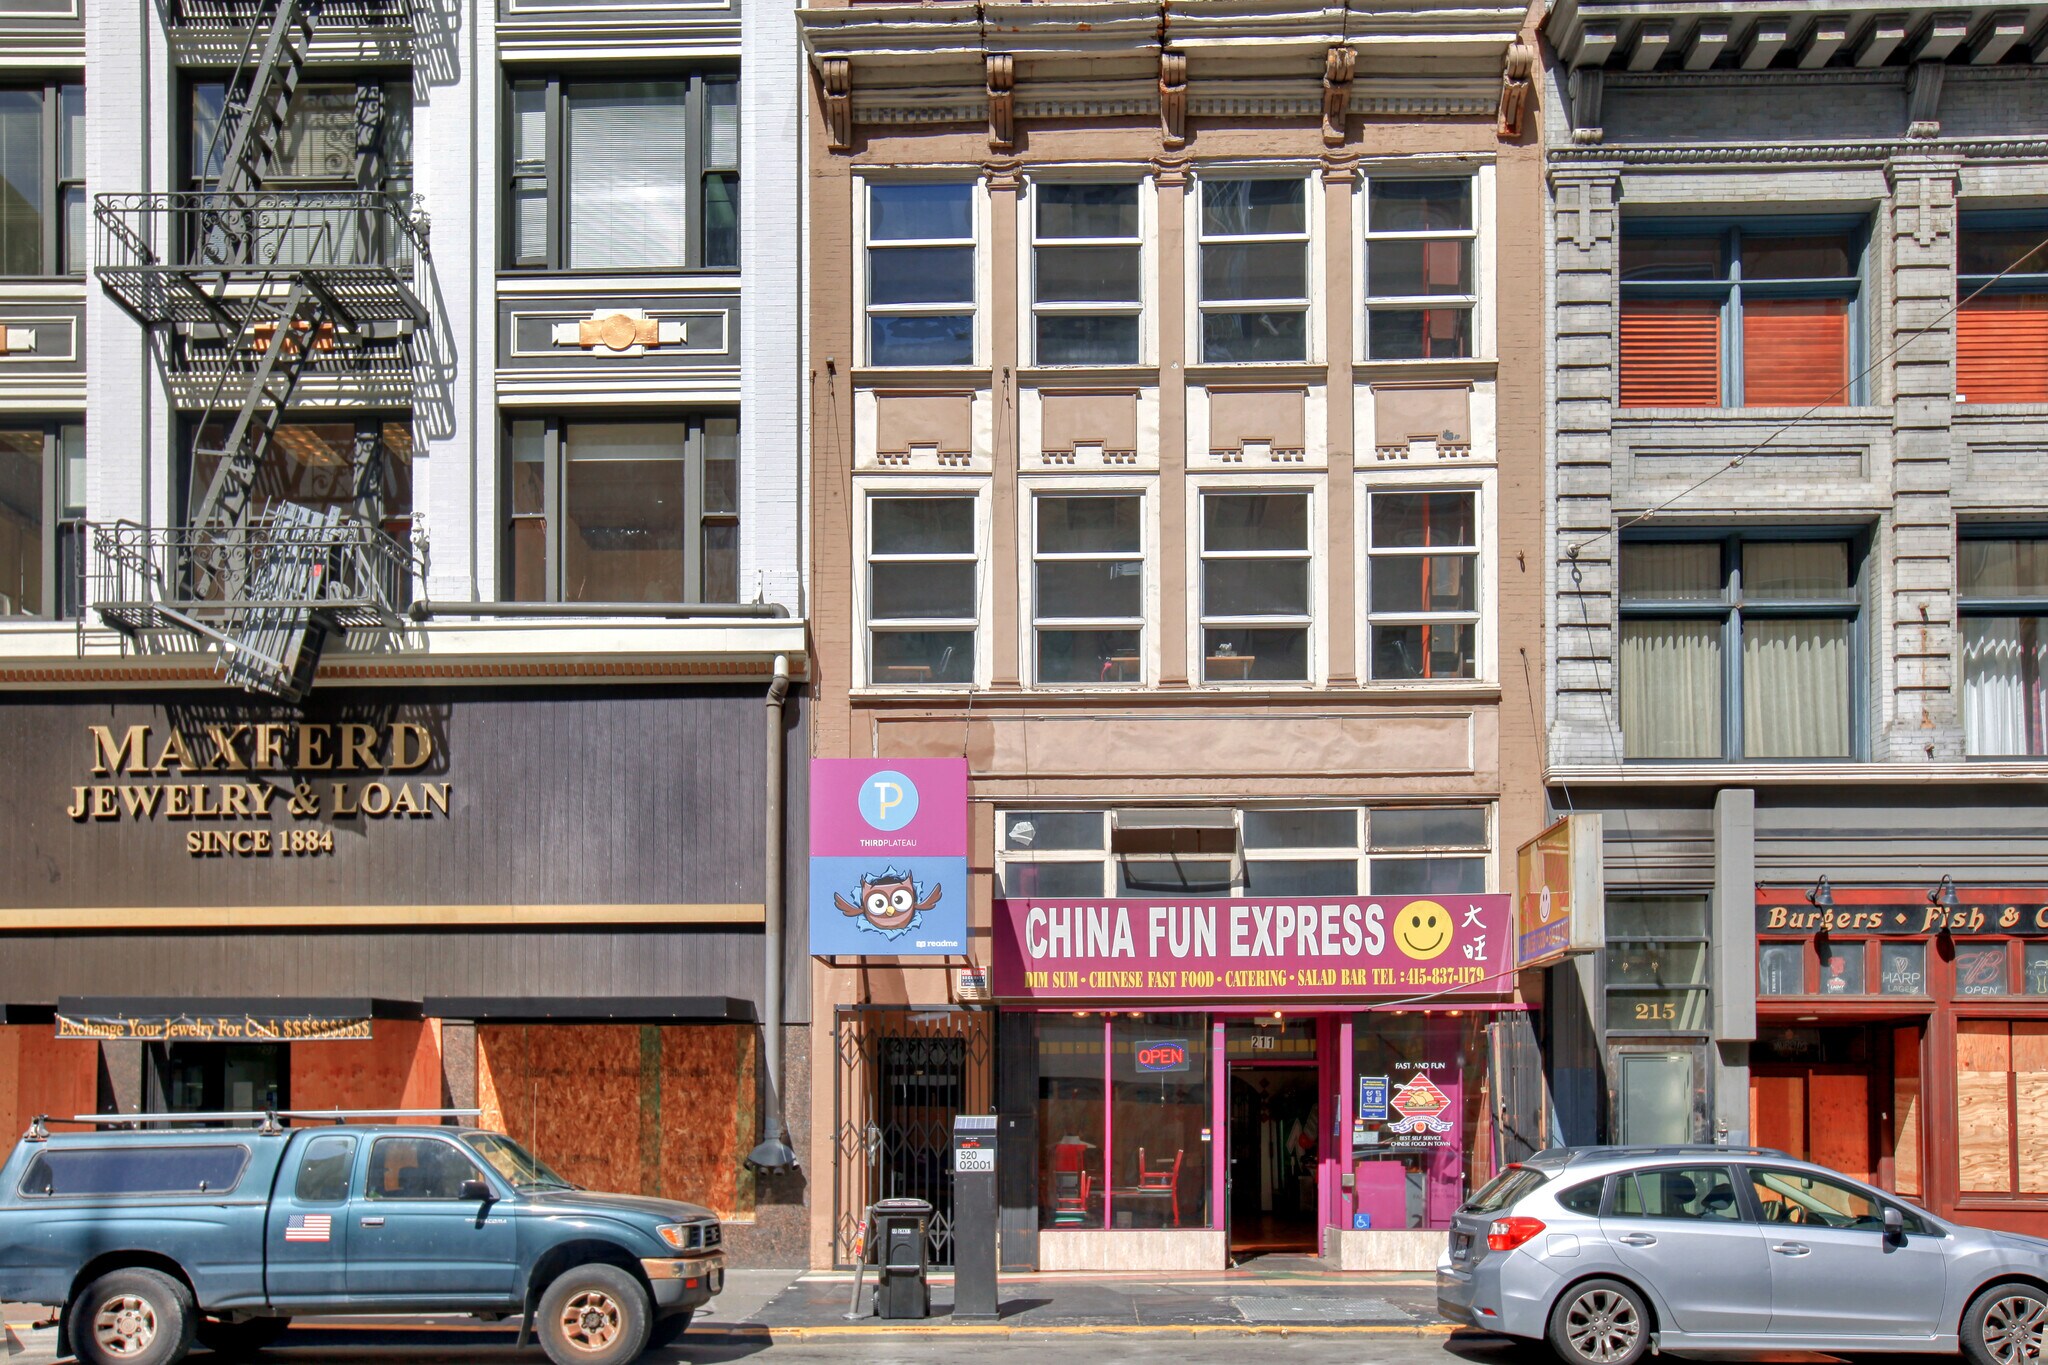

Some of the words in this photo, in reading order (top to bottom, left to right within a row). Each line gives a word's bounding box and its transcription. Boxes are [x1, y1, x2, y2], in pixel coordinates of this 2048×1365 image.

[88, 723, 432, 772] MAXFERD
[67, 783, 276, 818] JEWELRY
[286, 783, 320, 816] &
[331, 782, 451, 815] LOAN
[186, 829, 271, 853] SINCE
[279, 829, 334, 852] 1884
[860, 839, 917, 847] THIRDPLATEAU
[1768, 907, 1883, 933] Burgers
[1921, 906, 1985, 933] Fish
[2000, 906, 2020, 928] &
[1025, 906, 1136, 959] CHINA
[1149, 906, 1216, 958] FUN
[1230, 903, 1386, 957] EXPRESS
[1025, 971, 1048, 988] DIM
[1052, 971, 1078, 988] SUM
[1089, 971, 1143, 988] CHINESE
[1148, 970, 1177, 988] FAST
[1181, 970, 1214, 987] FOOD
[1225, 969, 1287, 987] CATERING
[1298, 968, 1336, 986] SALAD
[1341, 968, 1366, 986] BAR
[1372, 968, 1396, 985] TEL
[1882, 972, 1920, 984] HARP
[1965, 986, 1998, 994] OPEN
[1635, 1003, 1676, 1020] 215
[60, 1019, 124, 1039] Exchange
[128, 1019, 161, 1037] Your
[164, 1018, 213, 1040] Jewelry
[218, 1019, 243, 1037] For
[245, 1020, 280, 1038] Cash
[1252, 1037, 1273, 1048] 211
[1138, 1048, 1183, 1064] OPEN
[960, 1150, 977, 1160] 520
[959, 1160, 991, 1170] 02001
